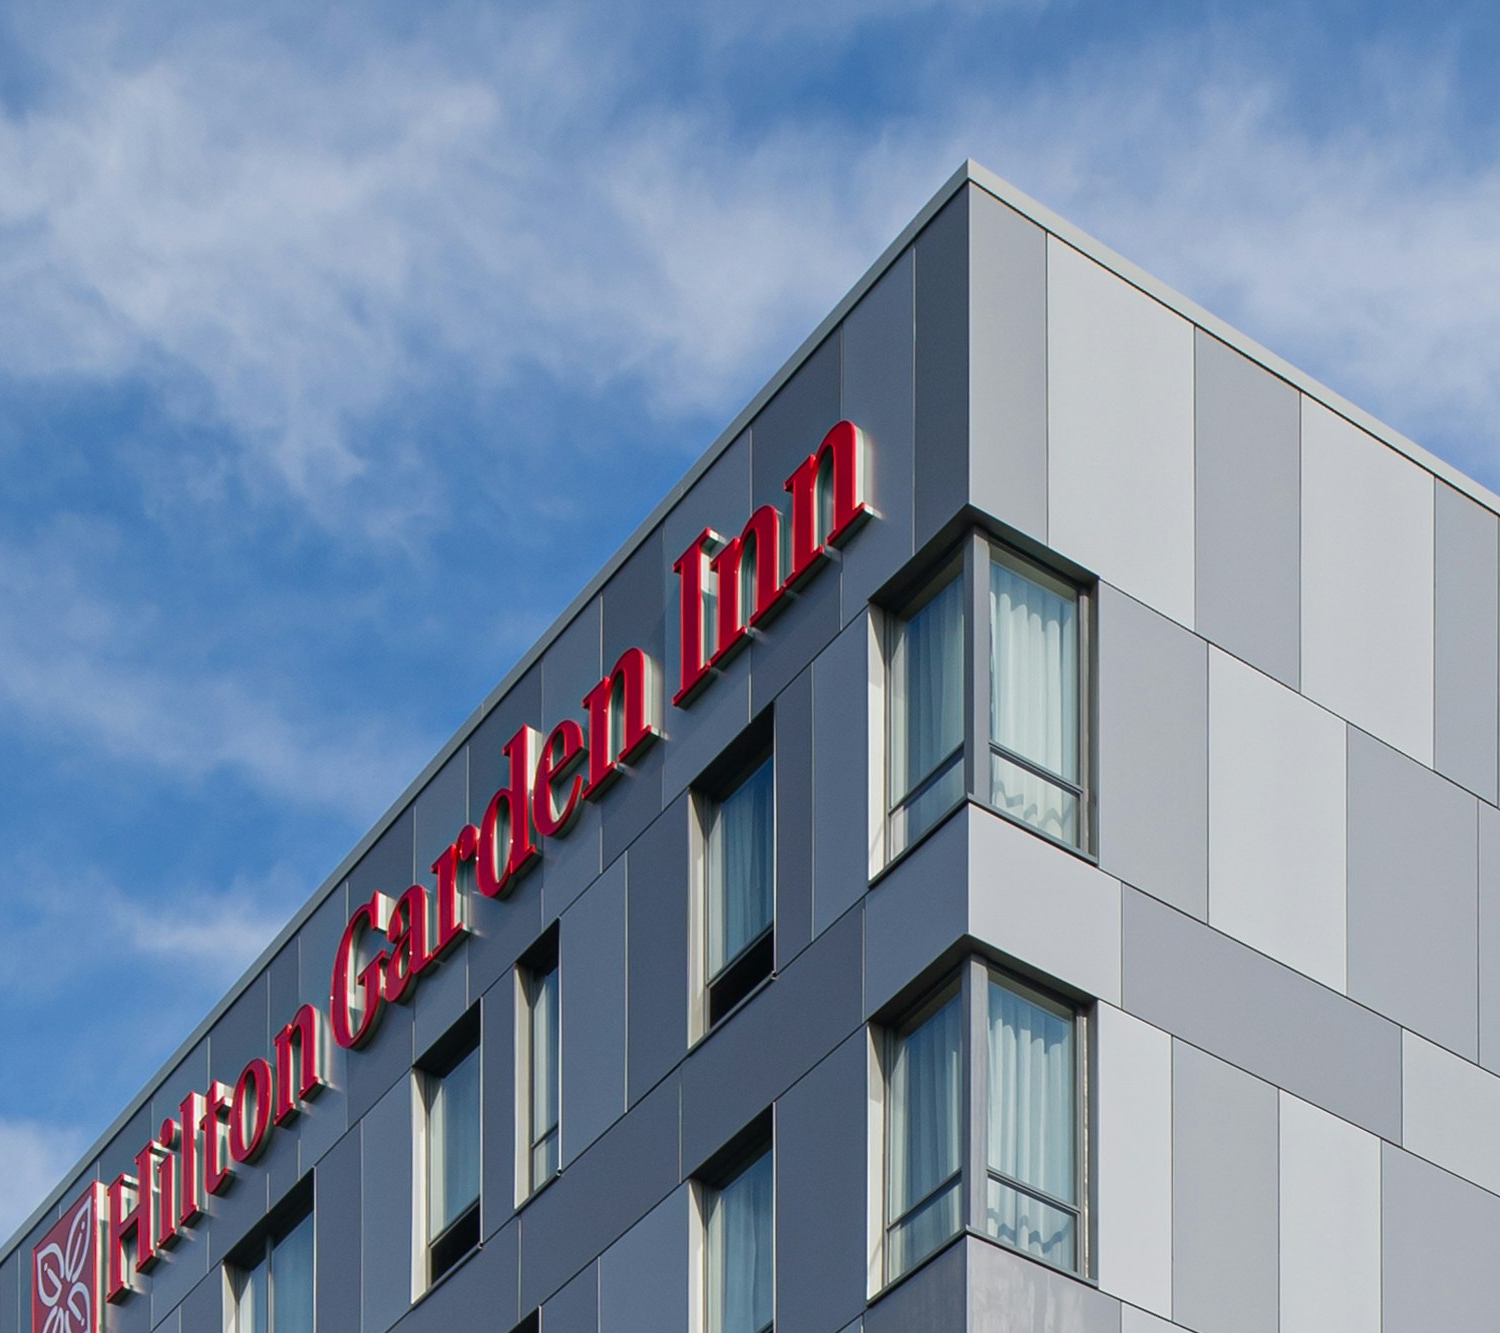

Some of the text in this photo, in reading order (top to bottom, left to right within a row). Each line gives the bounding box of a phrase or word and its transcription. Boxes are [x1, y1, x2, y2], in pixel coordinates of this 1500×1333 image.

[105, 419, 868, 1305] Hilton Garden Inn
